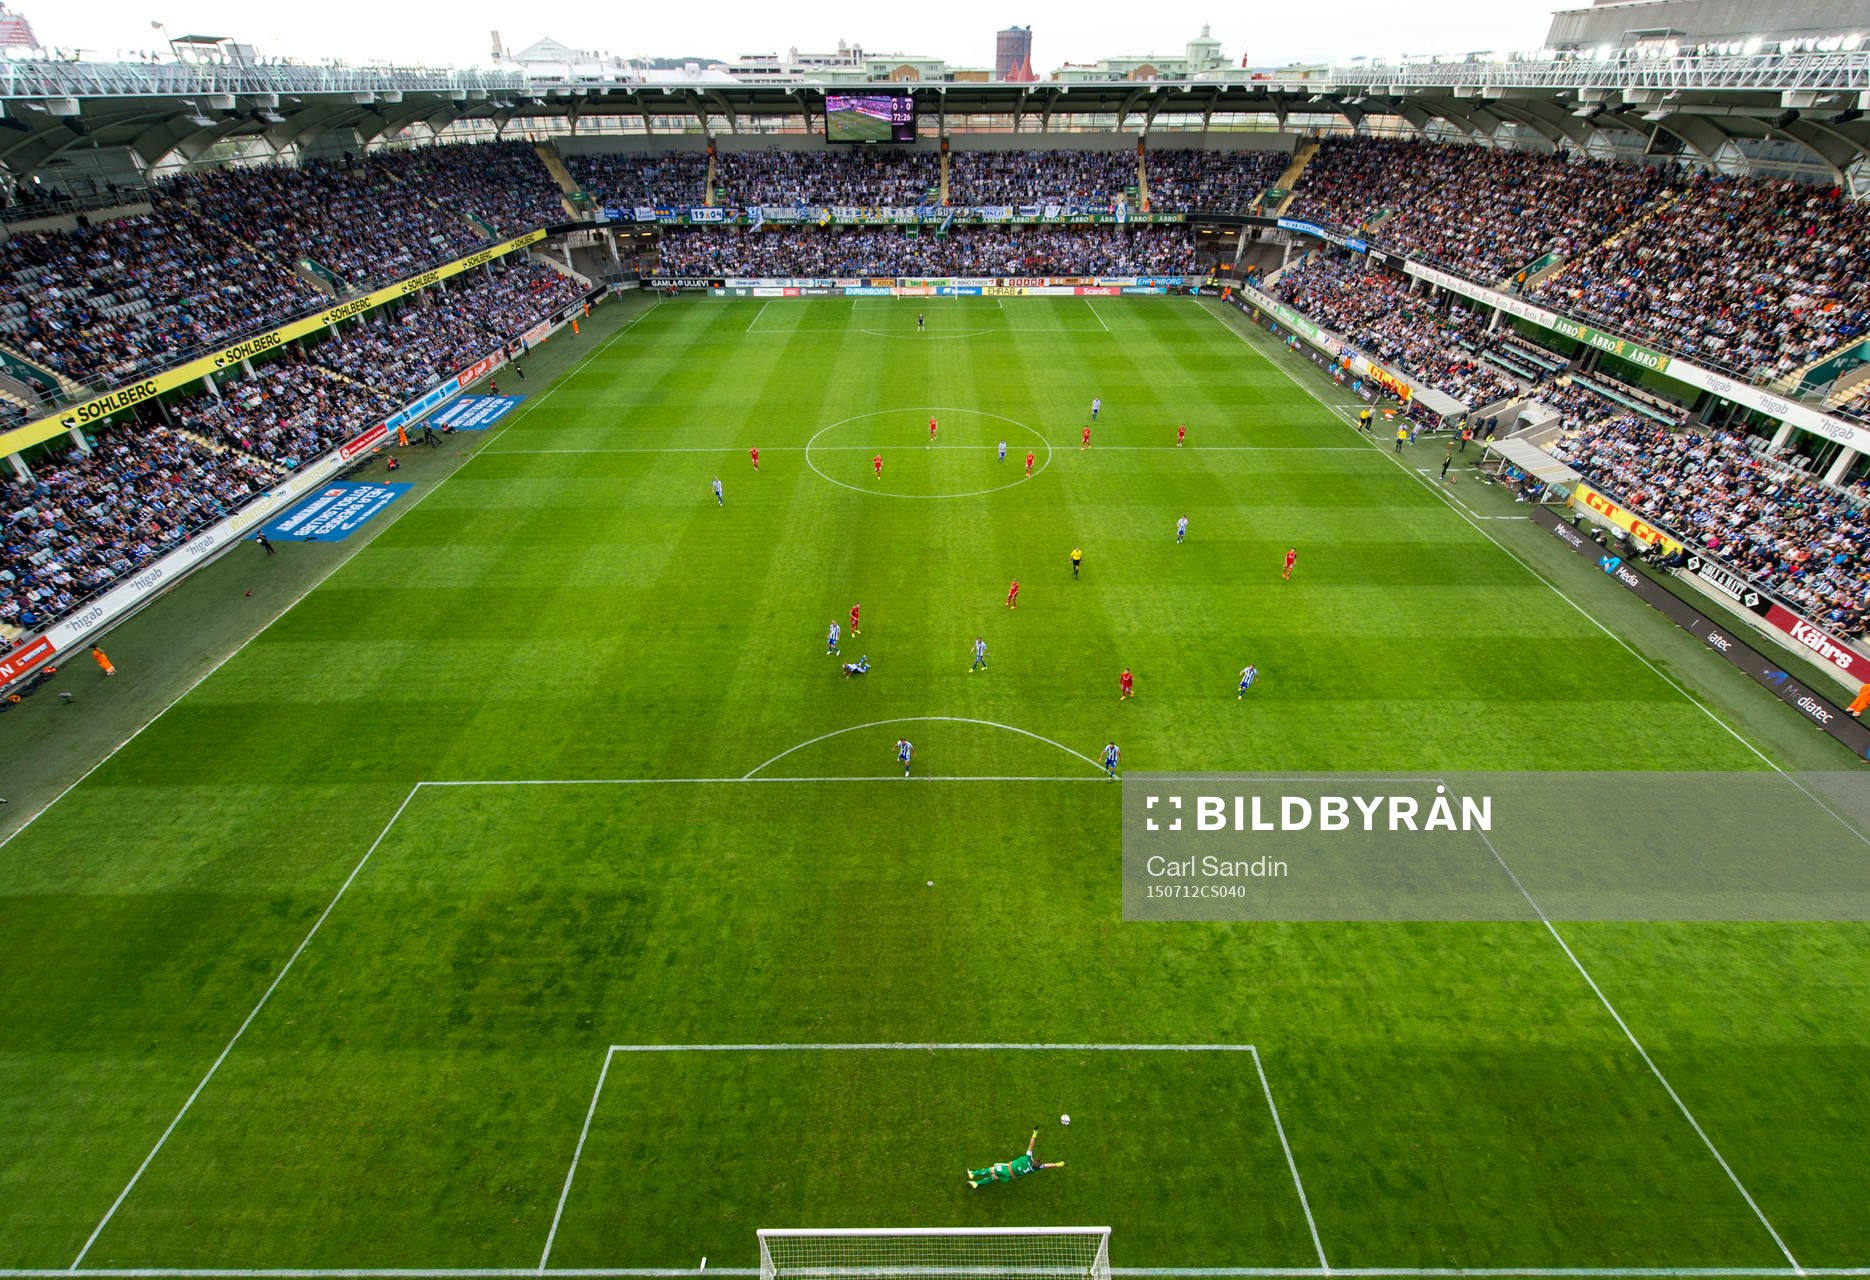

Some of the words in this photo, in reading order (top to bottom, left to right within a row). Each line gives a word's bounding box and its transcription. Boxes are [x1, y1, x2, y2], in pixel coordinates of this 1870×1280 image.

[893, 113, 911, 121] 72:26
[514, 233, 535, 249] SOHLBERG
[467, 250, 493, 267] SOHLBERG
[408, 271, 440, 291] SOHLBERG
[1083, 287, 1111, 295] Scandic
[330, 297, 371, 322] SOHLBERG
[1555, 320, 1579, 337] ÅBRO
[225, 332, 281, 363] SOHLBERG
[1590, 333, 1616, 351] ÅBRO
[1629, 349, 1658, 367] ÅBRO
[77, 381, 158, 423] SOHLBERG
[1585, 492, 1619, 519] GT
[1630, 519, 1667, 544] GT
[1615, 566, 1639, 587] Media
[1706, 630, 1733, 652] iatec
[1789, 620, 1853, 669] Kährs
